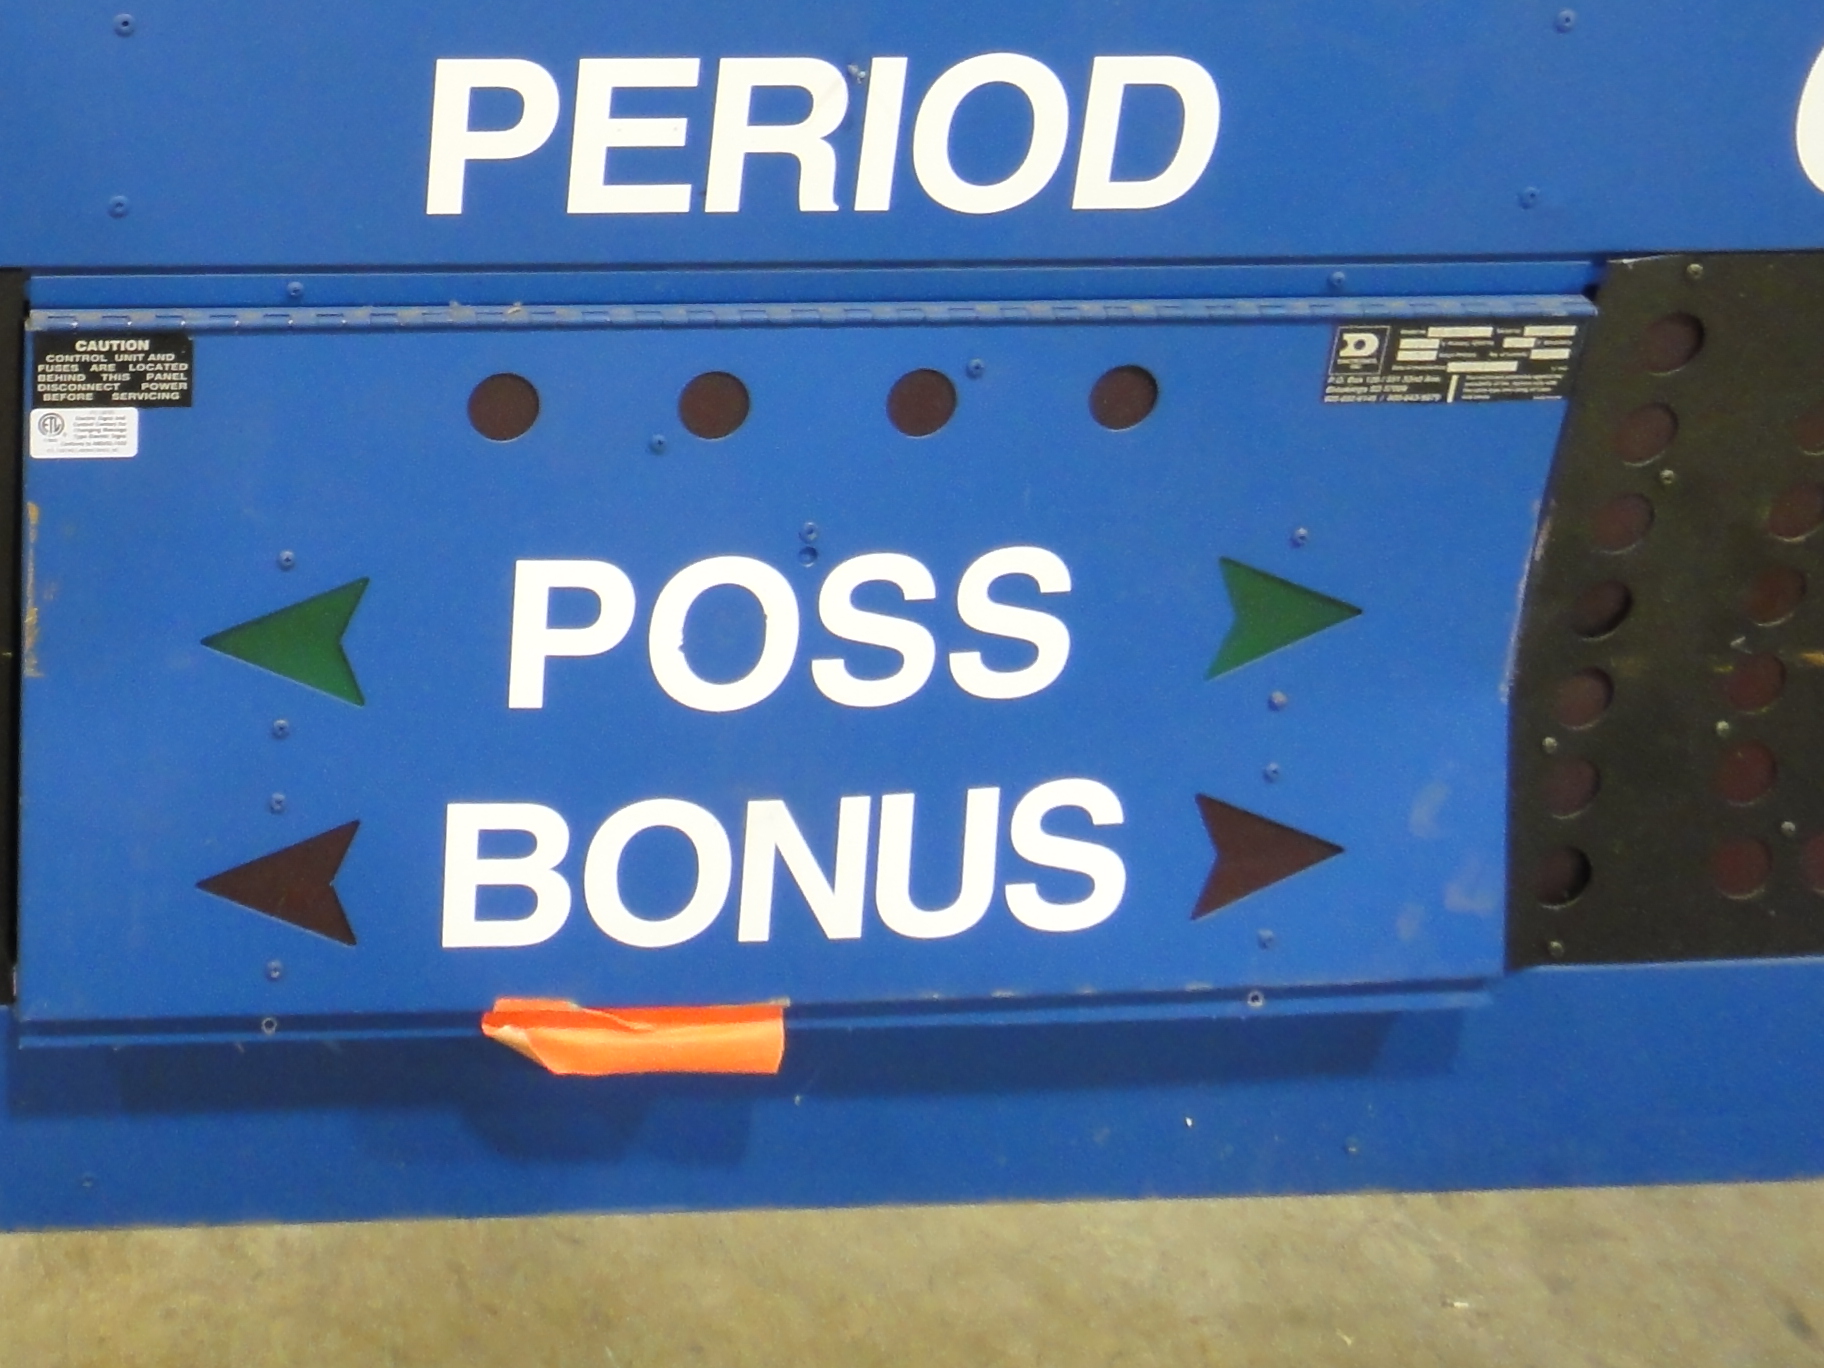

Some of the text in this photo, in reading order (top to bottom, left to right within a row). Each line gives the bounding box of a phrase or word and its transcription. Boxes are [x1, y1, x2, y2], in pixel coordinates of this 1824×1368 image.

[426, 52, 1221, 215] PERIOD
[75, 339, 150, 352] CAUTION
[45, 353, 175, 362] CONTROL UNIT AND
[37, 363, 188, 372] FUSES ARE LOCATED
[37, 372, 188, 382] BEHIND THIS PANEL
[37, 382, 188, 392] DISCONNECT POWER
[43, 392, 180, 401] BEFORE SERVICING
[508, 545, 1072, 713] POSS
[442, 777, 1126, 949] BONUS
